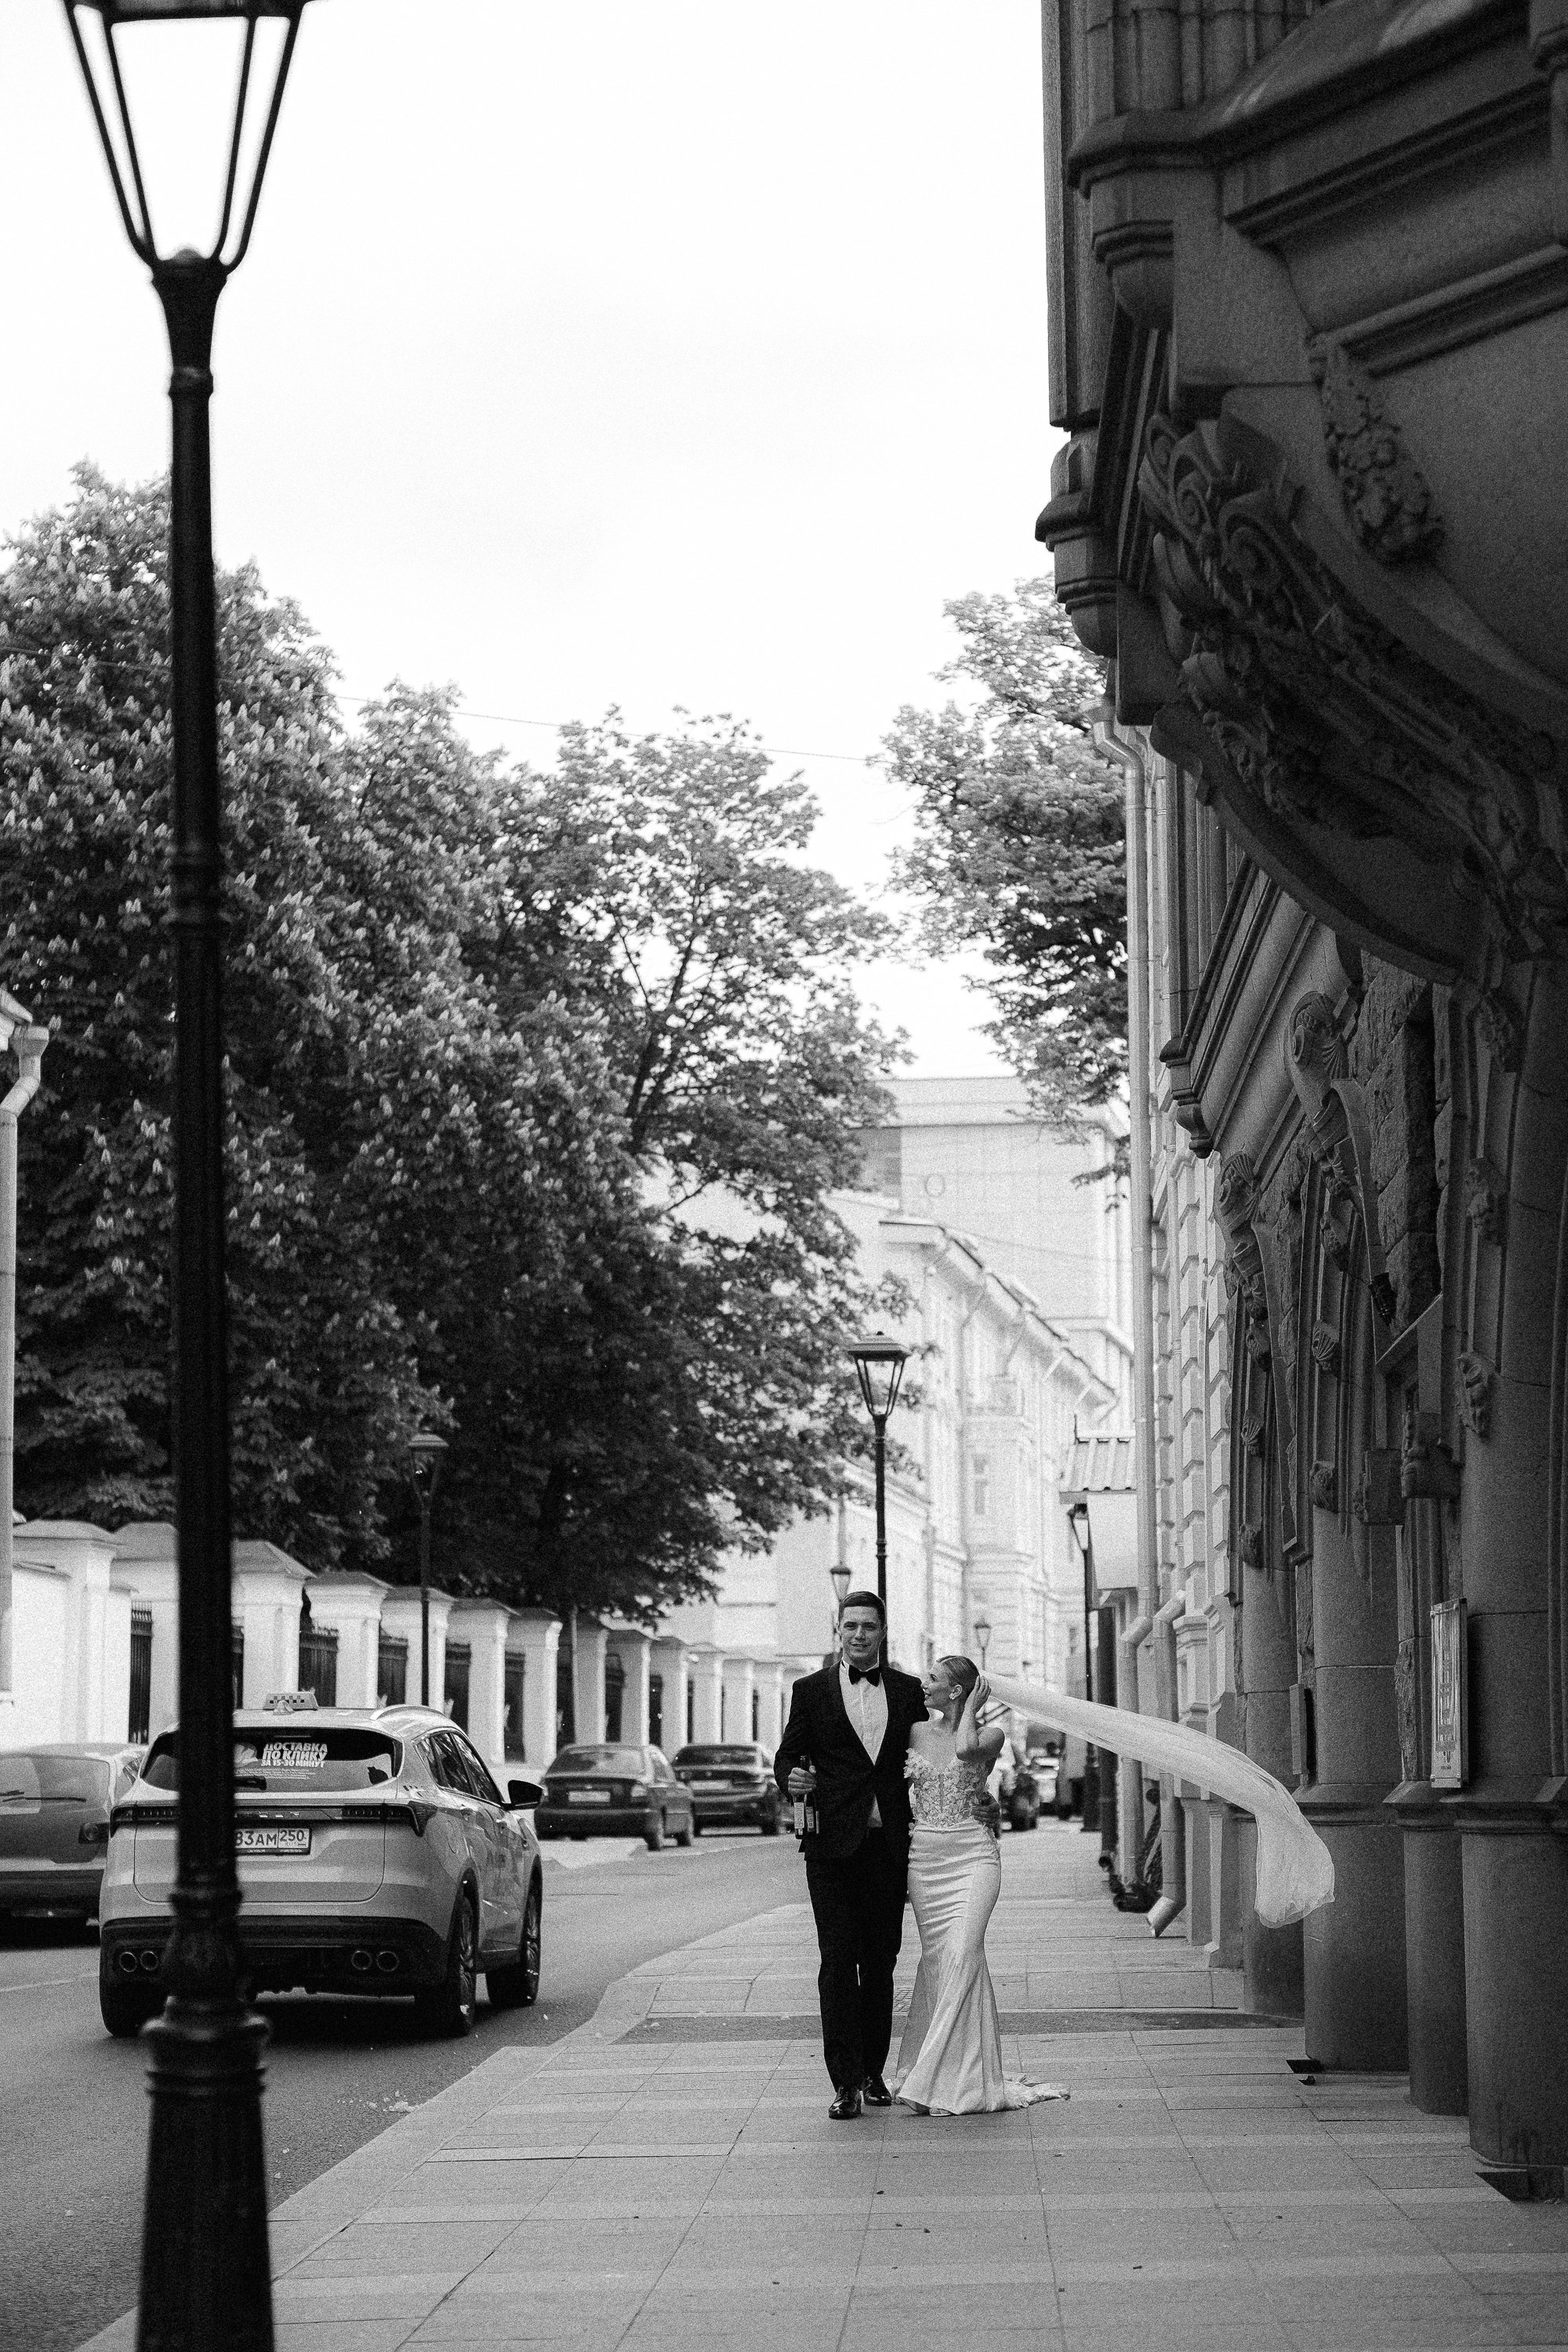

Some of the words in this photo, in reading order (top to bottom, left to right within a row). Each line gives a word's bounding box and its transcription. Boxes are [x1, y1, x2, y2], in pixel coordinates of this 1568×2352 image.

[264, 1742, 328, 1752] ДОСТАВКА
[263, 1751, 281, 1760] ПО
[282, 1751, 328, 1762] КЛИКУ
[280, 1830, 305, 1842] 250
